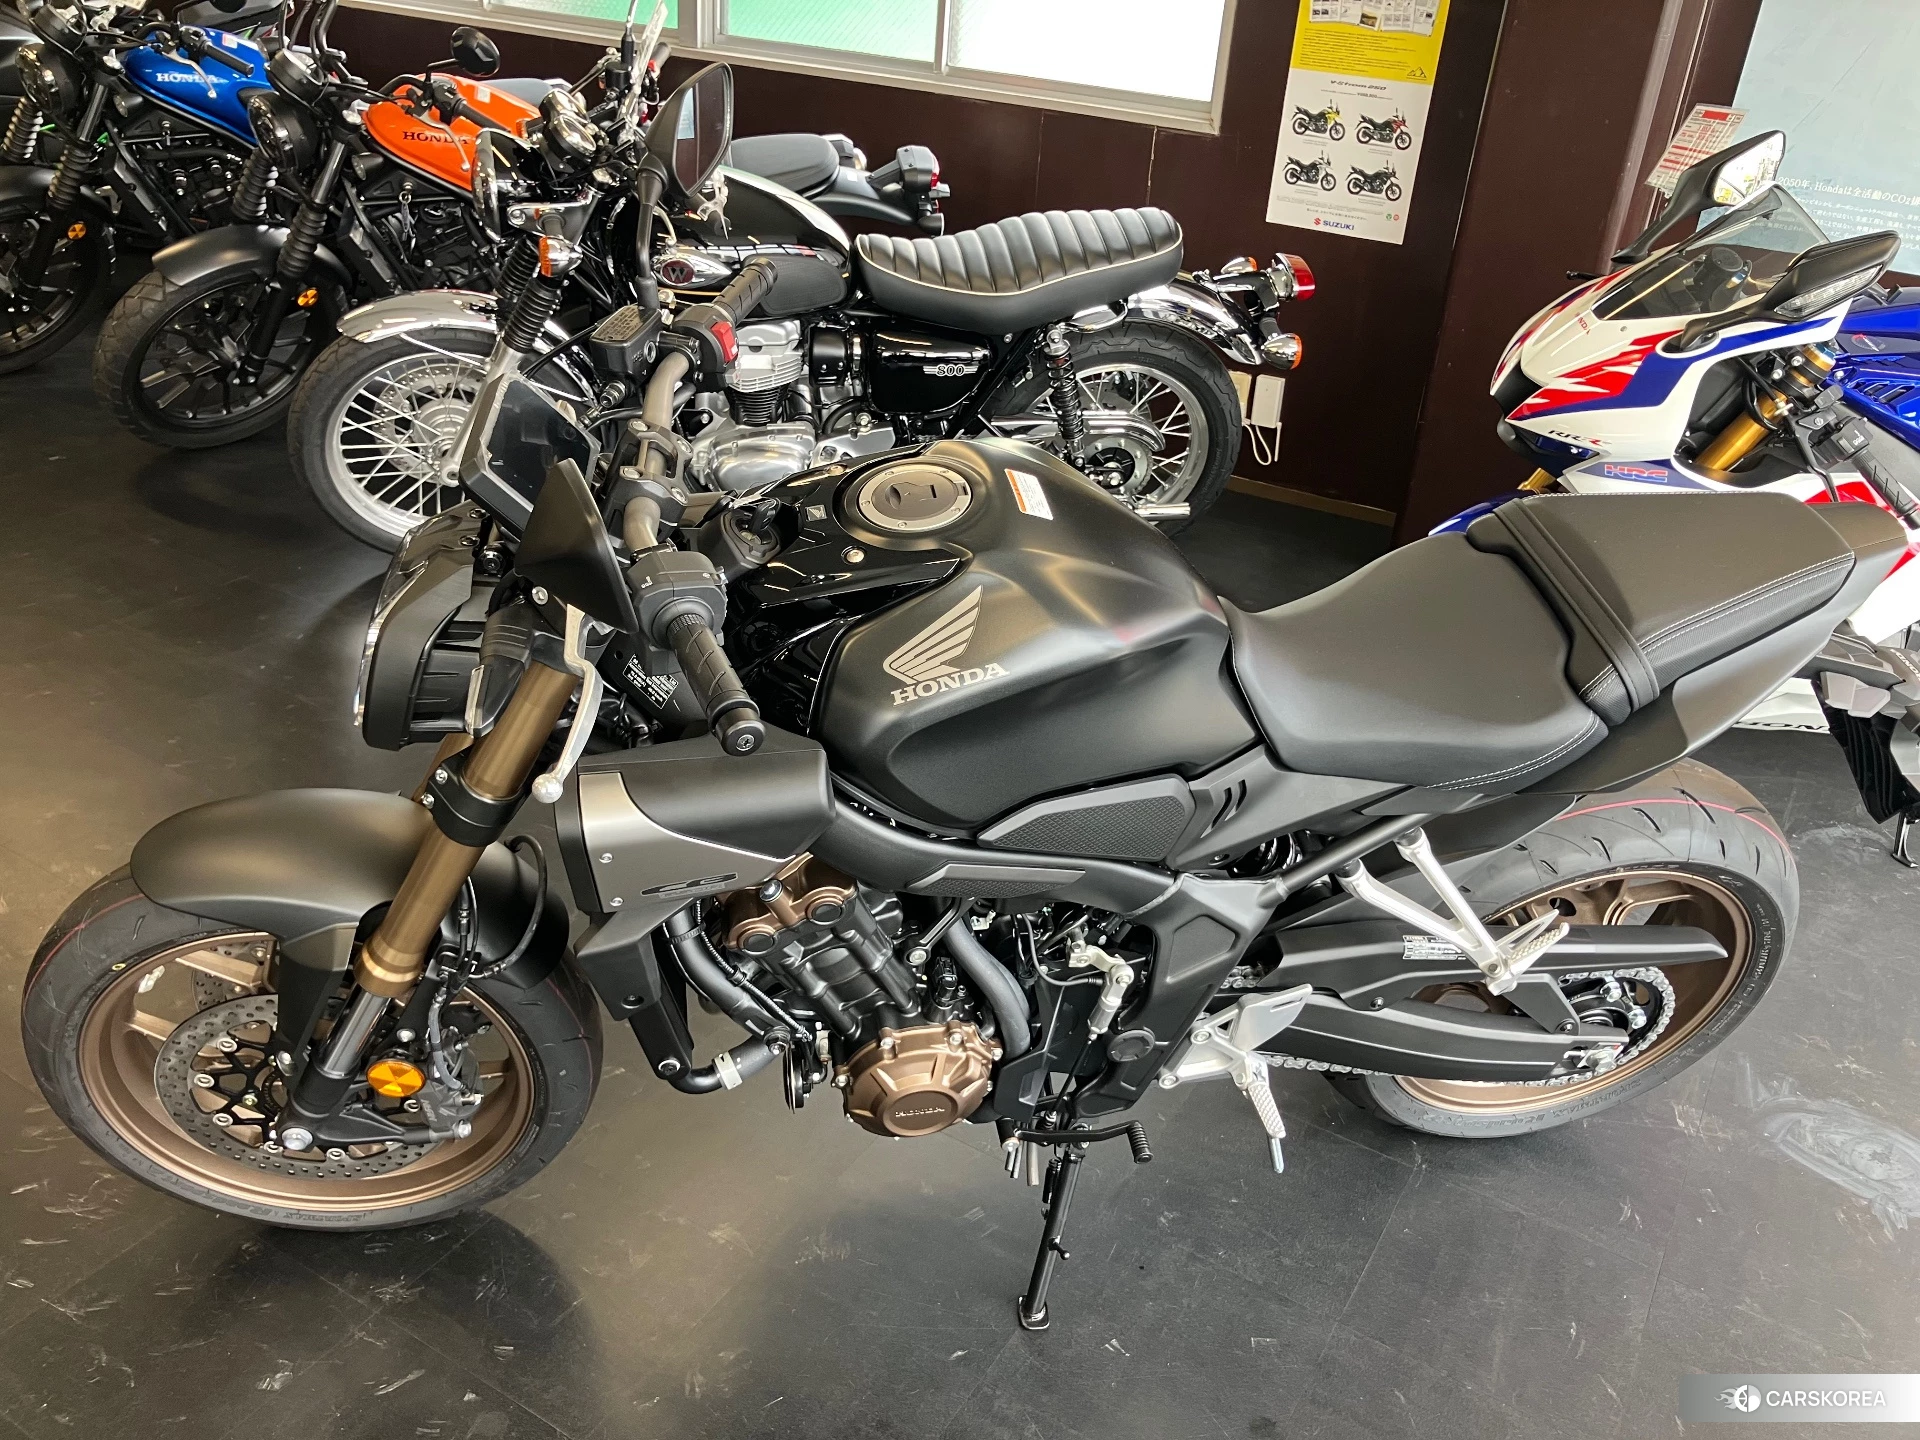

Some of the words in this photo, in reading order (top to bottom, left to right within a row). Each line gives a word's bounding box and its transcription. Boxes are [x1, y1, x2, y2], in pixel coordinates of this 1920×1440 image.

[1322, 220, 1355, 230] SUZUKI
[667, 266, 688, 282] W
[936, 364, 966, 377] 800
[1604, 464, 1668, 483] HRC
[890, 662, 1010, 706] HONDA
[895, 1107, 945, 1118] HONDA
